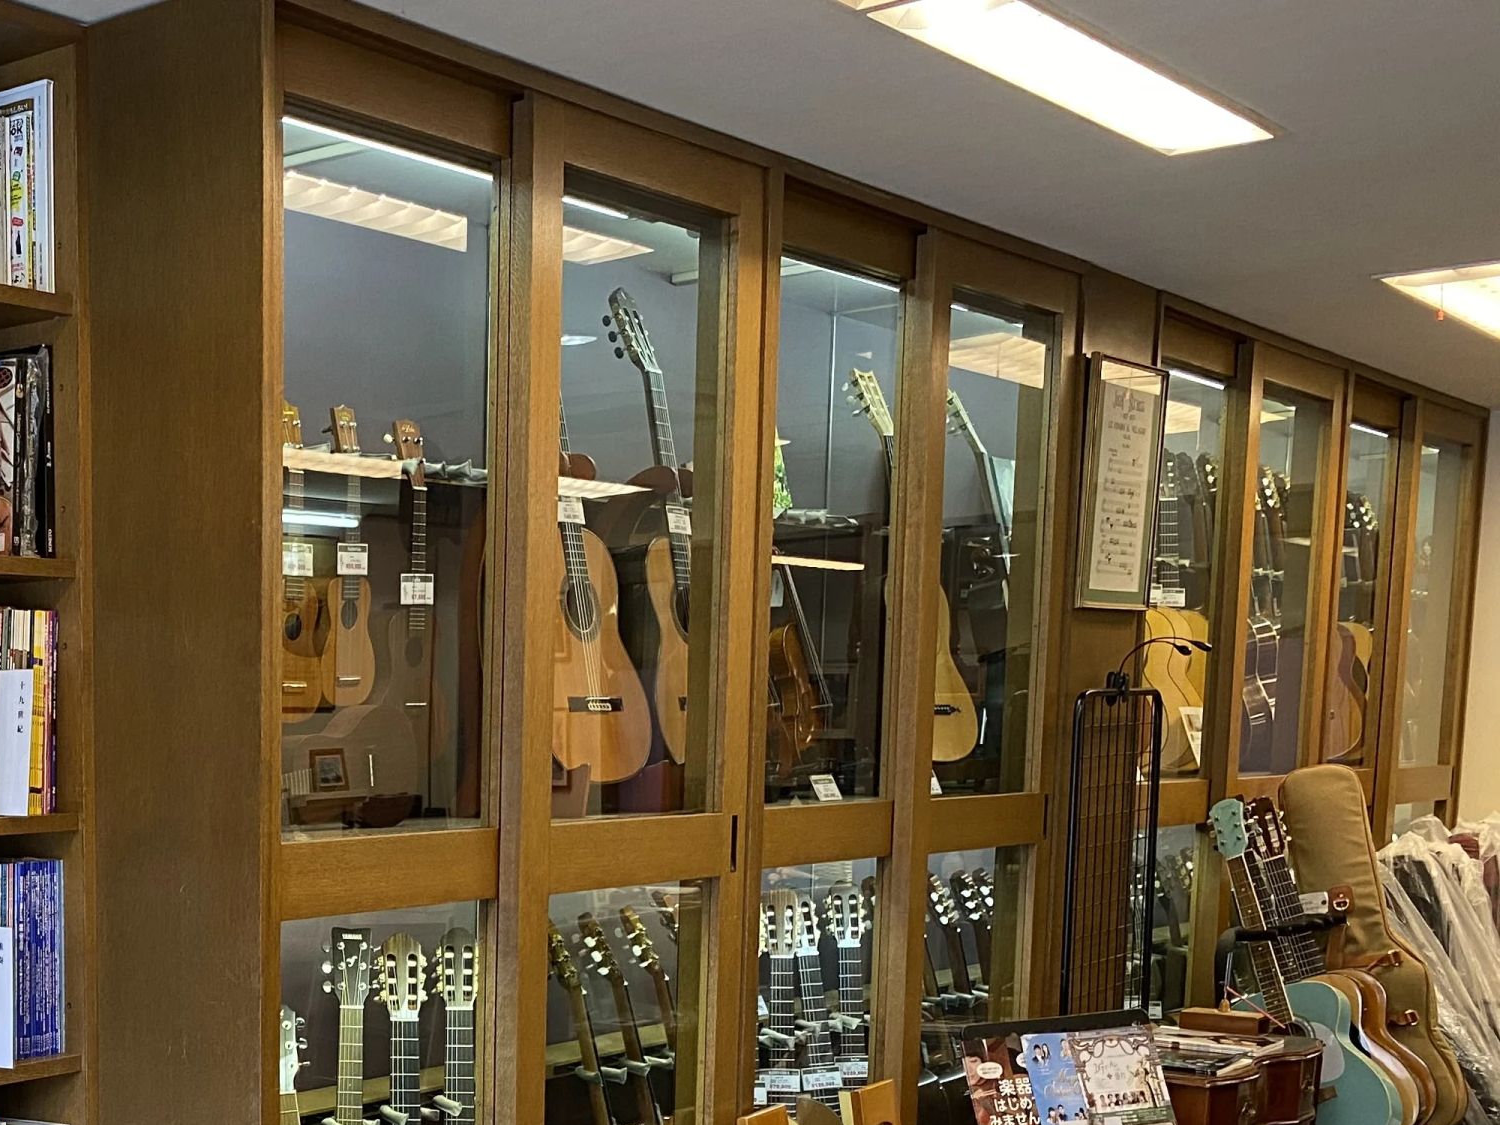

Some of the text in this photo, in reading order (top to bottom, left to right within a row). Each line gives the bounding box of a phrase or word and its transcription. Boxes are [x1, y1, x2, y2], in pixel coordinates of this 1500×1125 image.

[998, 1078, 1032, 1096] 楽器
[994, 1097, 1033, 1112] はじめ
